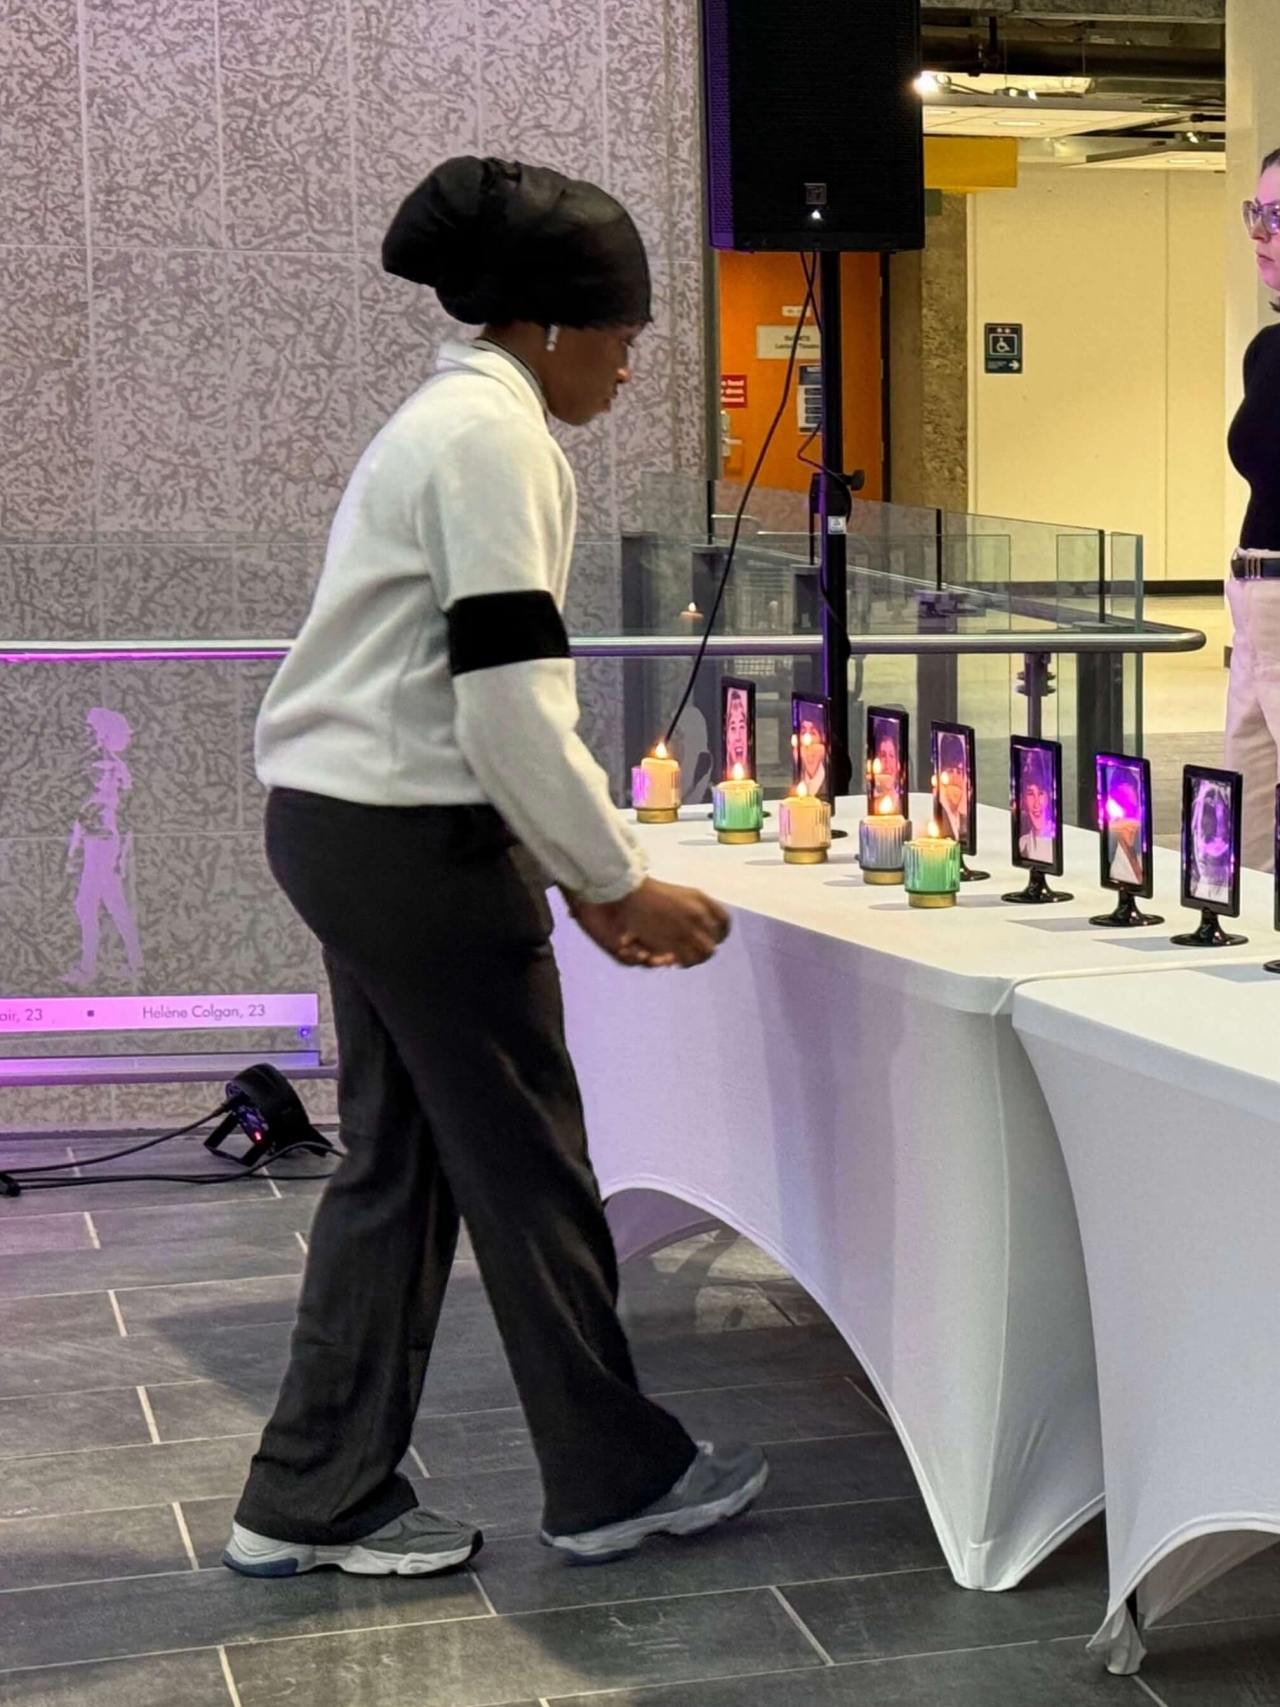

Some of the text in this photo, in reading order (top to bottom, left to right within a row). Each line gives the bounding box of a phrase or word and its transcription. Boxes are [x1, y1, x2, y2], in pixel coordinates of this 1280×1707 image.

[25, 1008, 43, 1021] 23
[142, 1003, 266, 1021] Hélène Colgan, 23
